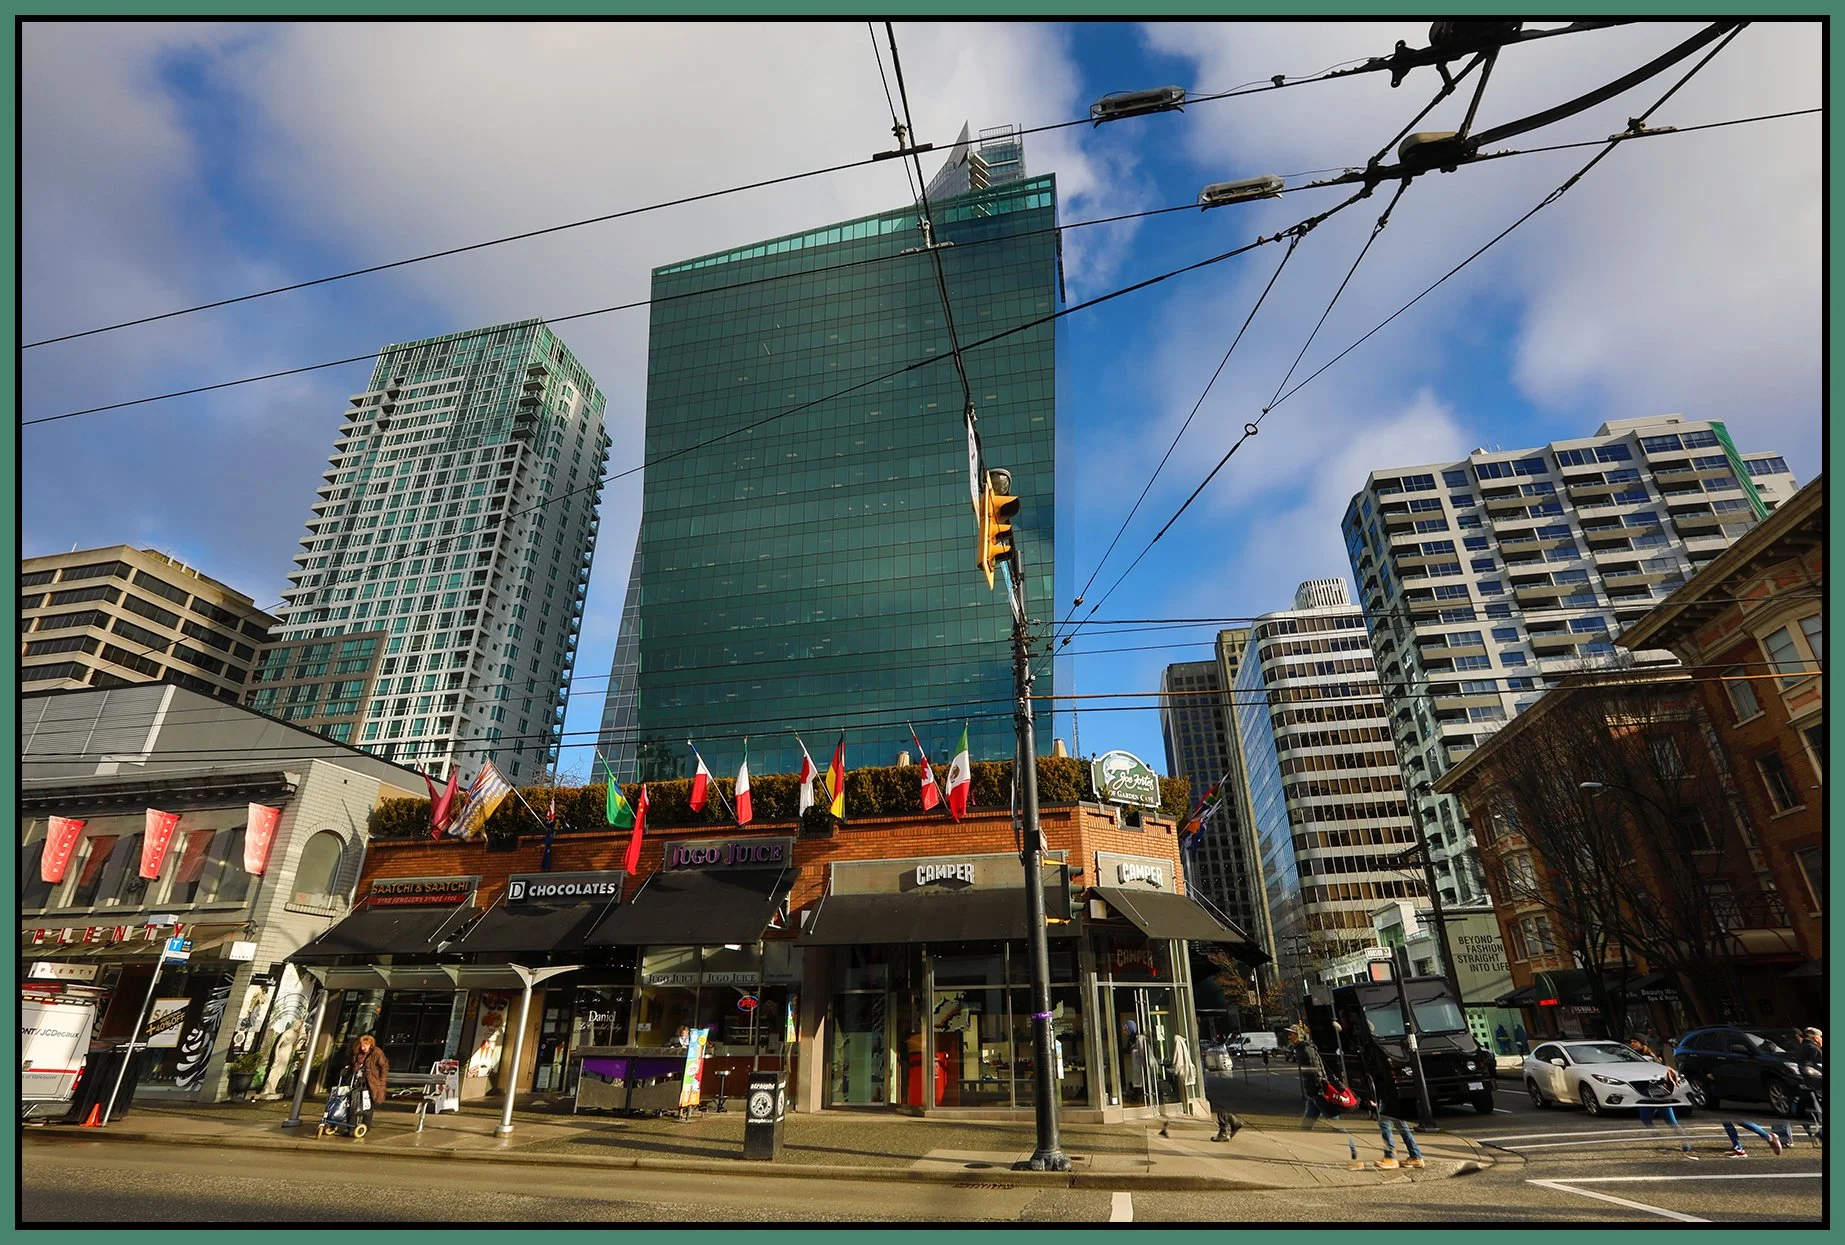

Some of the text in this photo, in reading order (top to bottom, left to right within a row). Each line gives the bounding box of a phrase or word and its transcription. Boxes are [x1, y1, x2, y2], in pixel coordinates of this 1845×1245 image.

[1113, 772, 1154, 790] Joe Fortes
[1117, 790, 1139, 800] GARDEN
[52, 825, 76, 873] PLENTY
[150, 819, 171, 868] PLENTY
[668, 843, 783, 866] JUGO JUICE
[916, 863, 975, 885] CAMPER
[1122, 863, 1163, 887] CAMPER
[371, 881, 468, 894] SAATCHI & SAATCHI
[529, 883, 616, 896] CHOCOLATES
[32, 923, 186, 944] PLENTY
[1458, 935, 1493, 945] BEYOND
[1466, 944, 1504, 954] FASHION
[1116, 948, 1154, 969] CAMPER
[1457, 954, 1500, 964] STRAIGHT
[40, 967, 94, 976] PLENTY
[1469, 962, 1510, 972] INTO LIFE
[647, 973, 695, 983] JUGO JUICE
[707, 973, 756, 983] JUGO JUICE
[589, 1010, 616, 1022] Daniel
